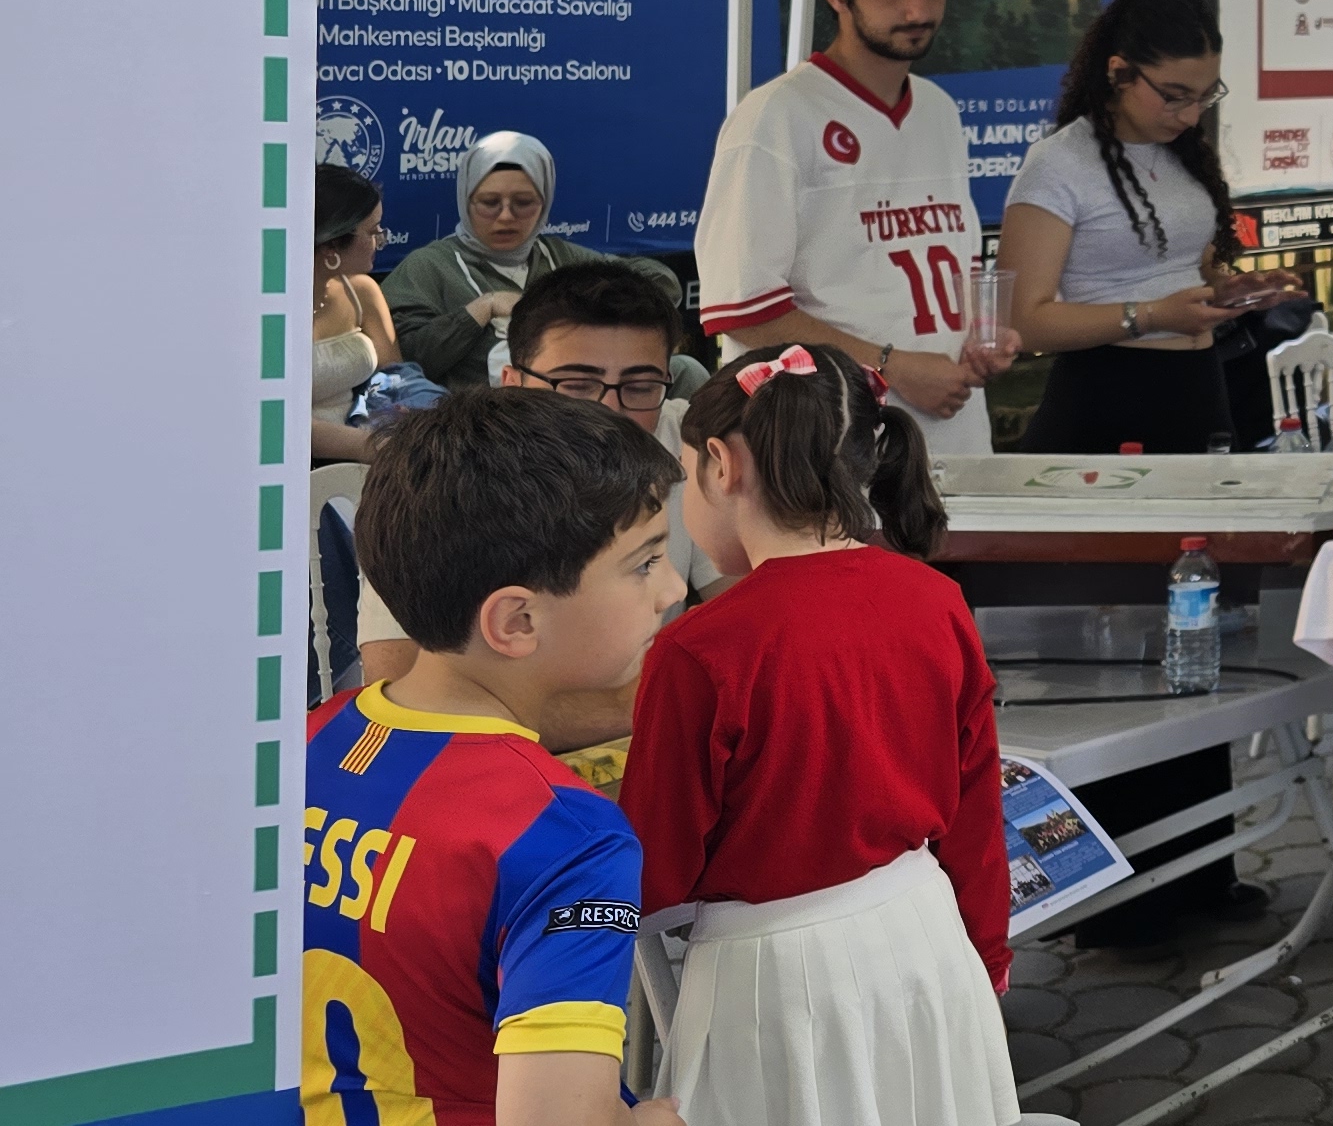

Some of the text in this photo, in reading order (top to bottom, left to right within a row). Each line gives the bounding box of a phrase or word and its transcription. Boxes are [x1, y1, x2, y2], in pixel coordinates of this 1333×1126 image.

[319, 24, 546, 53] Mahkemesi Başkanlığı
[317, 60, 631, 85] avcı Odası 10 Duruşma Salonu
[399, 107, 478, 162] İrfan
[860, 195, 966, 243] TÜRKİYE
[888, 245, 966, 336] 10
[580, 907, 640, 928] RESPECT
